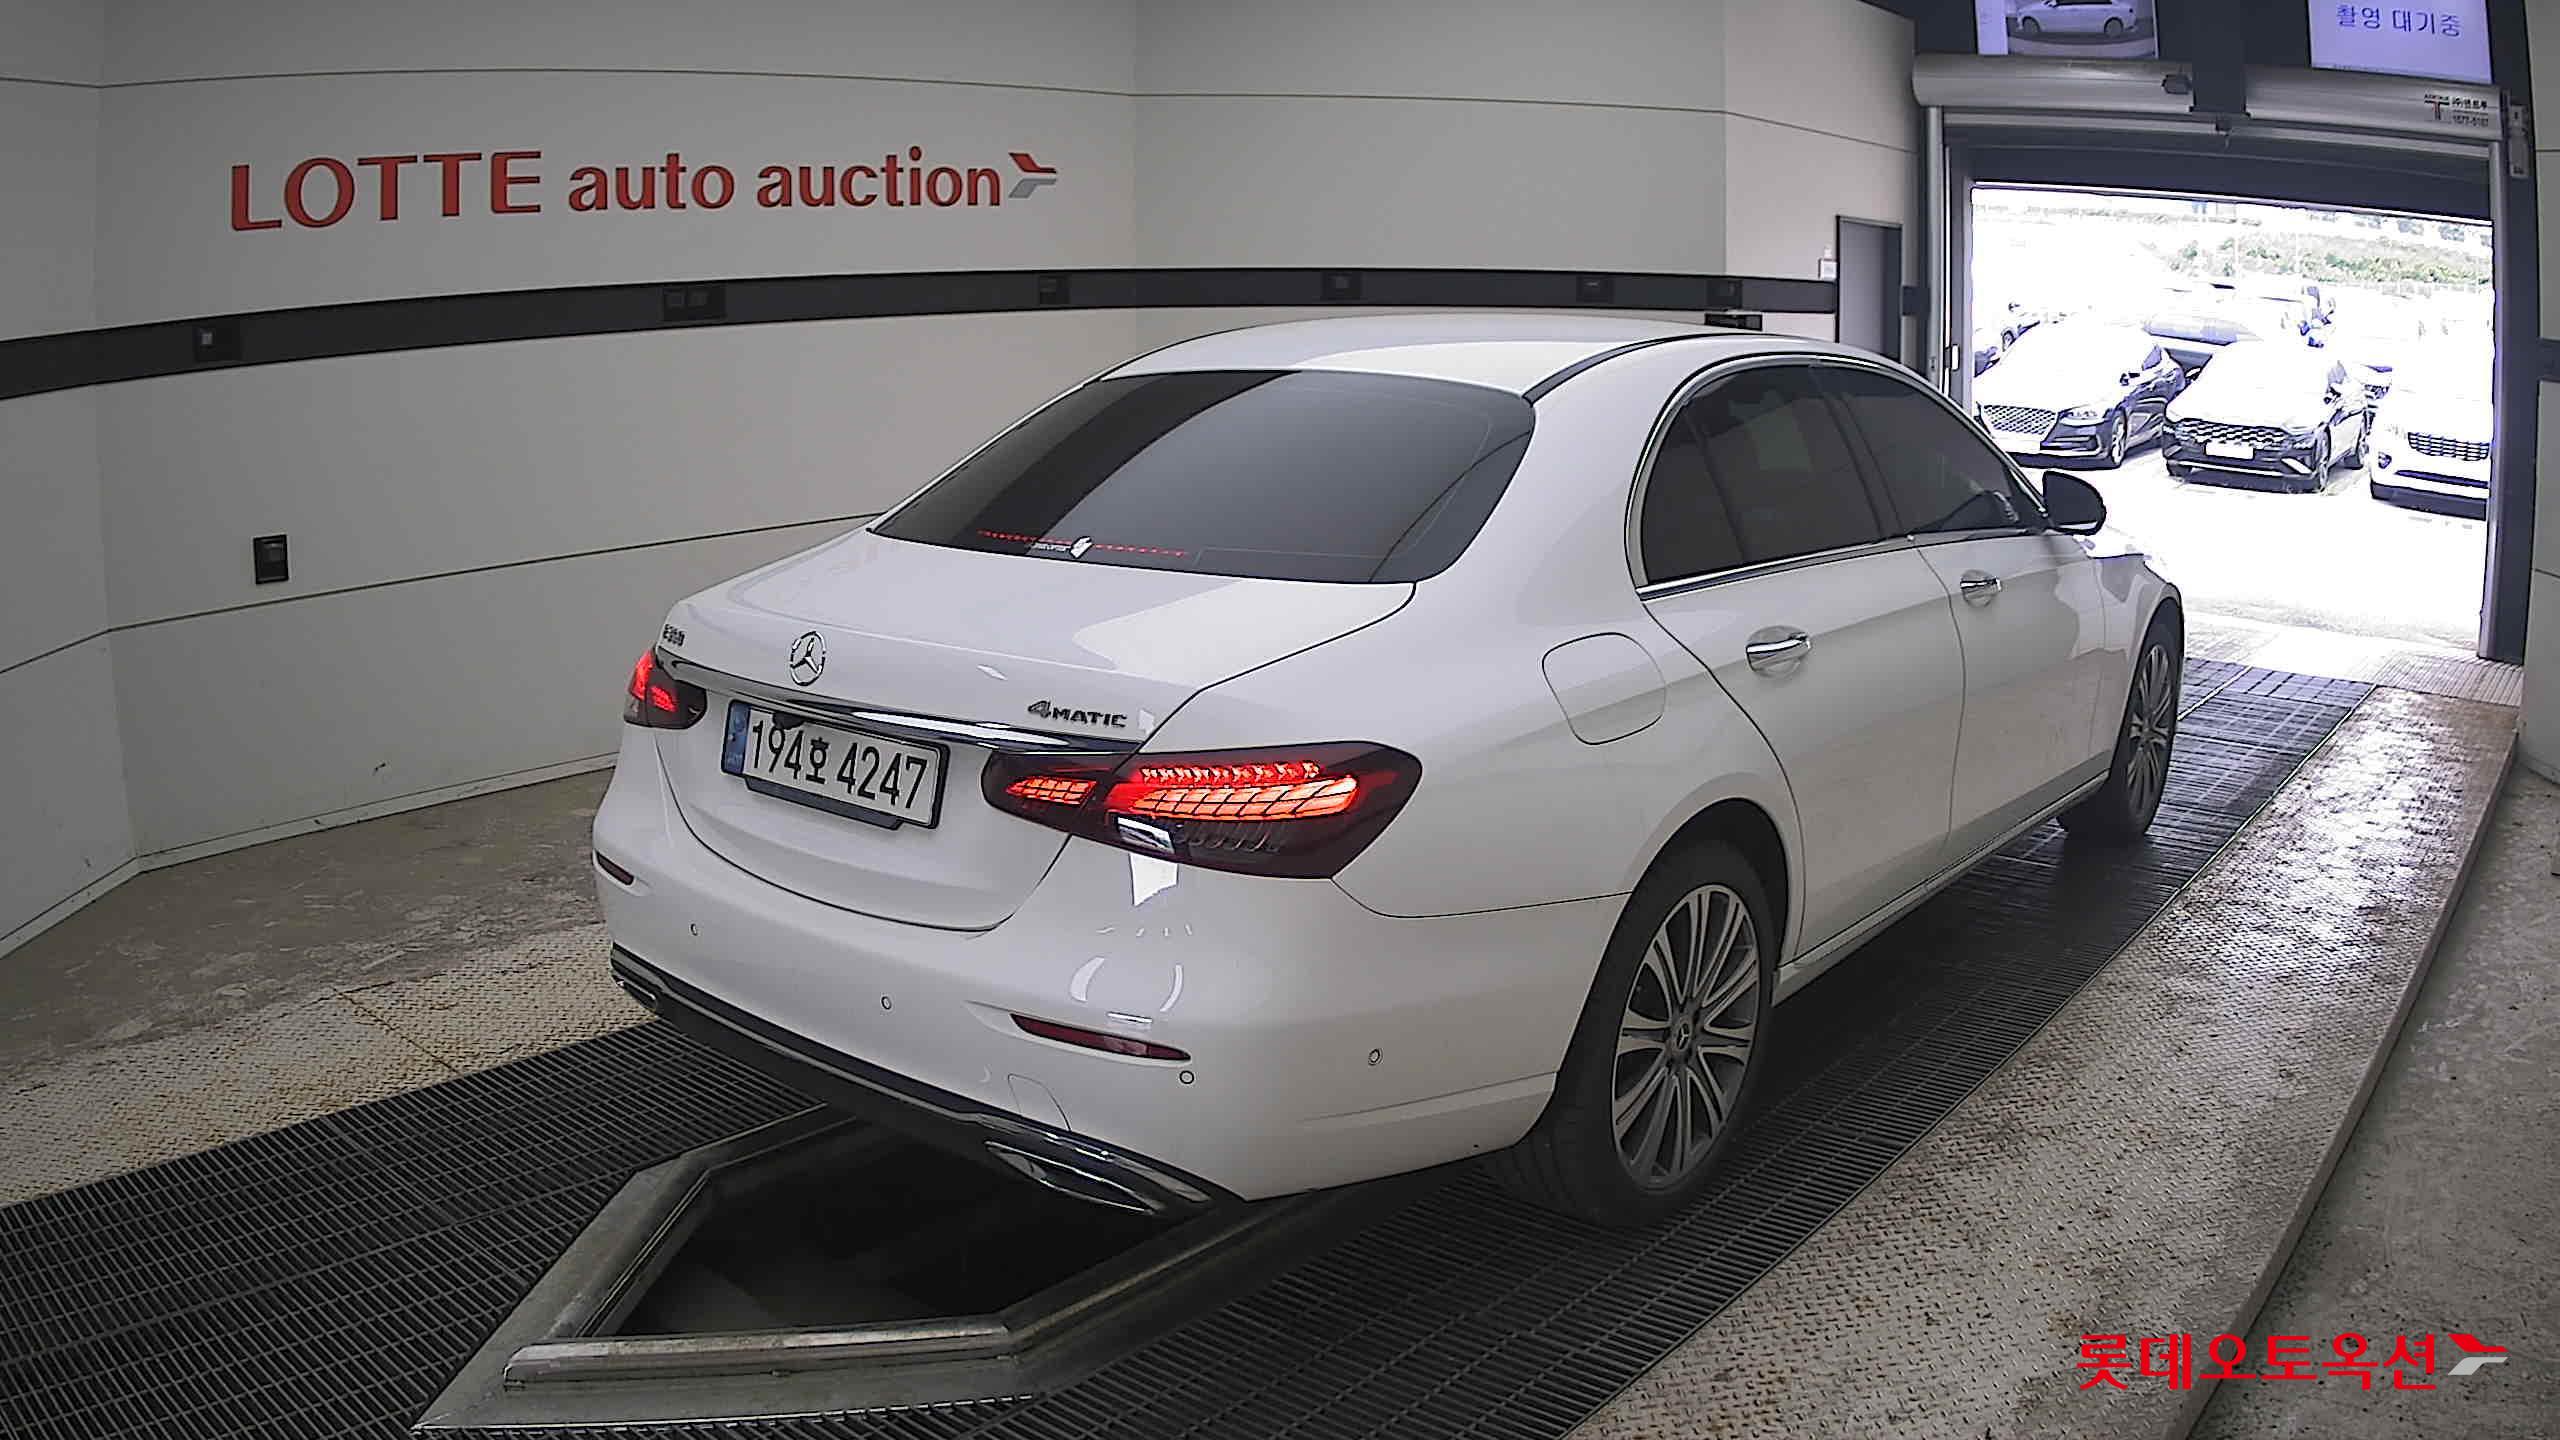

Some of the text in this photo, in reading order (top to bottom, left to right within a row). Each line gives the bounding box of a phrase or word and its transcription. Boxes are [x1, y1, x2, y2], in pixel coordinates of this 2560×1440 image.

[2336, 4, 2461, 38] 촬영 대기중
[231, 145, 1001, 232] LOTTE auto auction
[1027, 699, 1128, 729] 4MATIC
[751, 719, 929, 810] 194호 4247
